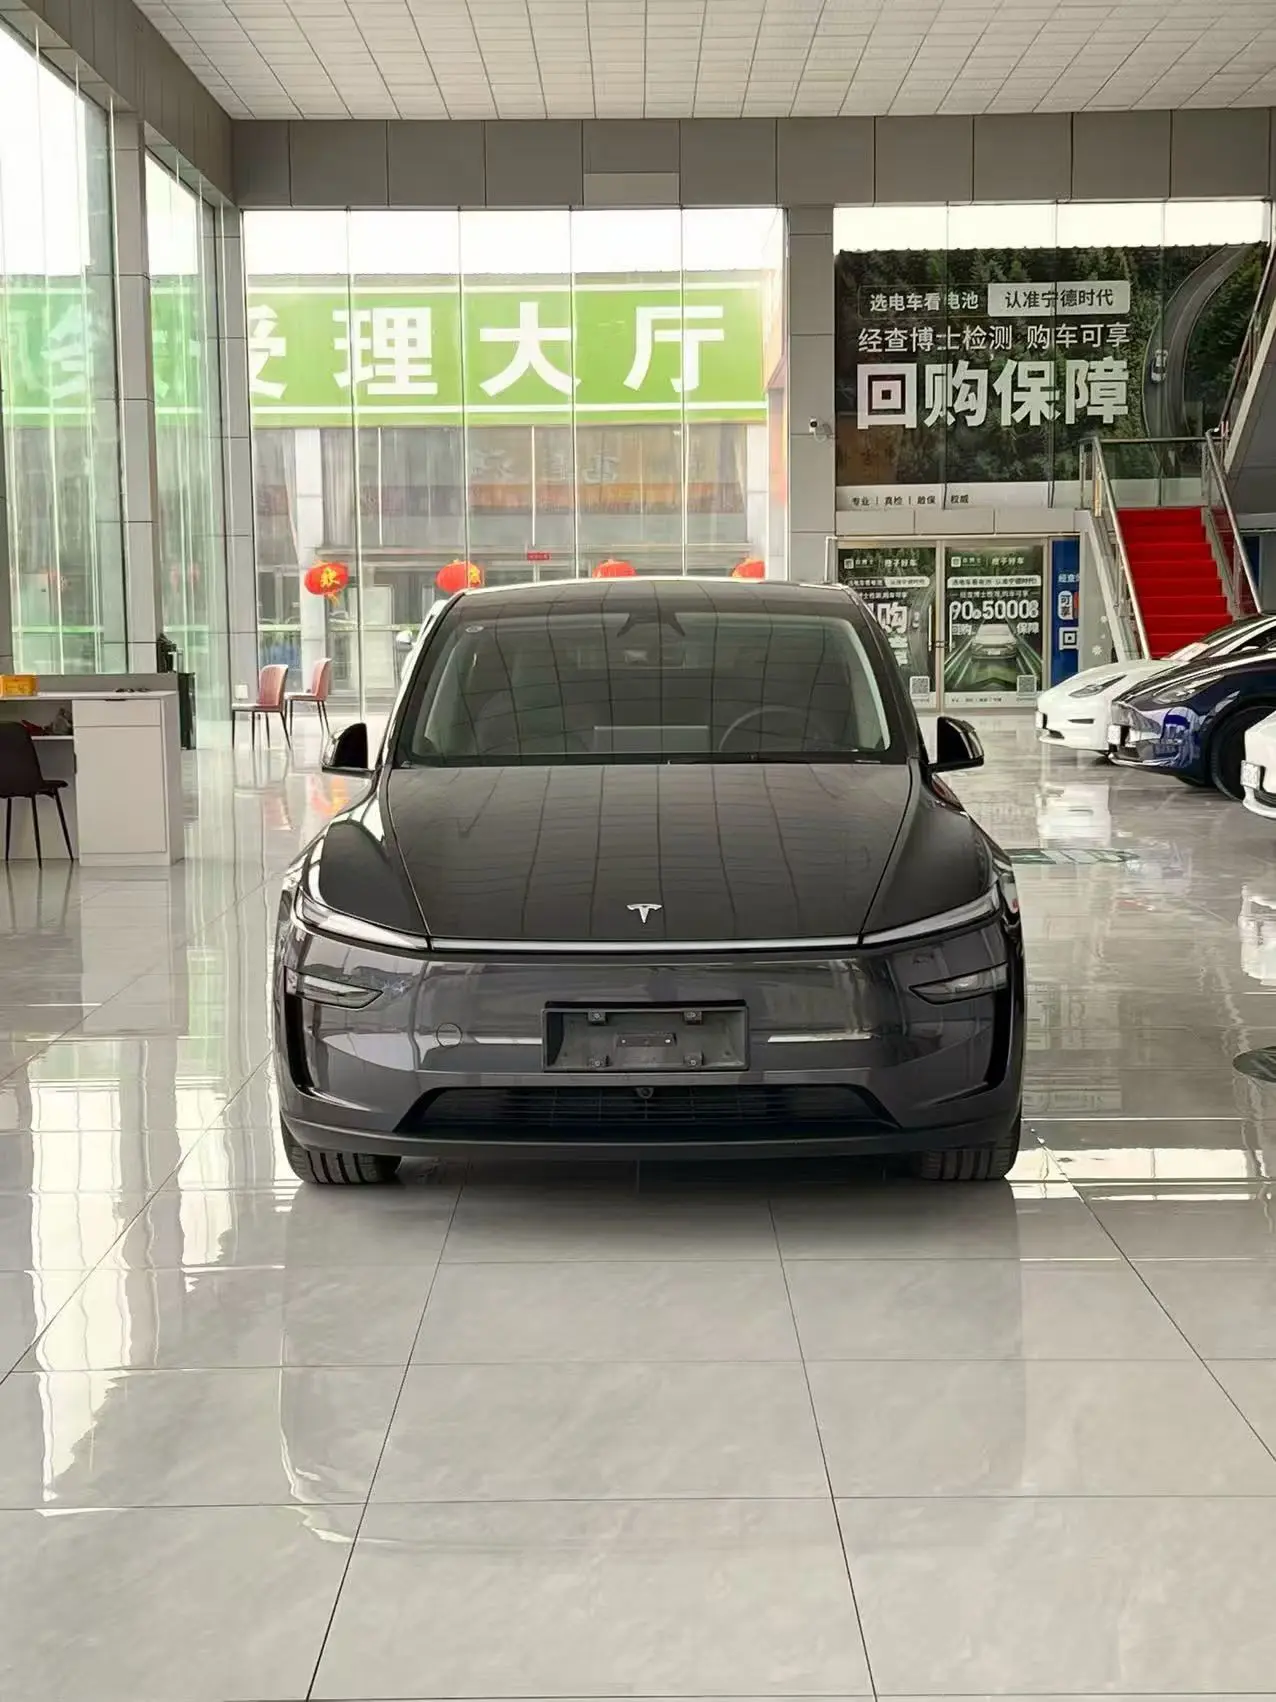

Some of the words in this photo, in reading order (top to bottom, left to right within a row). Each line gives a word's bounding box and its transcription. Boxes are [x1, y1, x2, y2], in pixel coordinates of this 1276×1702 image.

[869, 292, 979, 312] 选电车看电池
[1004, 289, 1114, 309] 认准宁德时代
[858, 324, 1013, 354] 经查博士检测
[1026, 321, 1132, 350] 购车可享
[857, 356, 1130, 430] 回购保障
[1060, 594, 1072, 617] 可享
